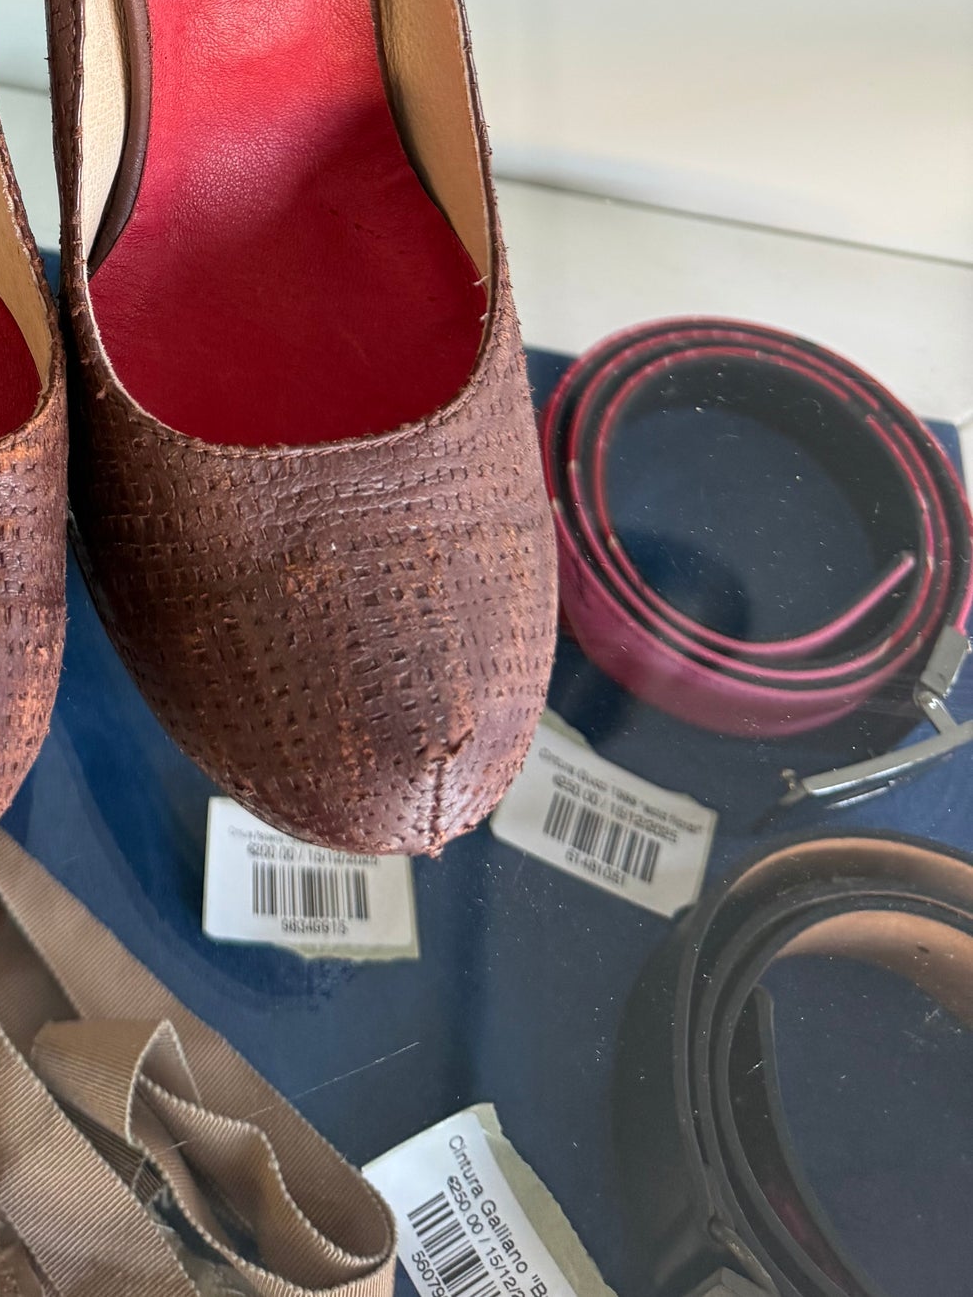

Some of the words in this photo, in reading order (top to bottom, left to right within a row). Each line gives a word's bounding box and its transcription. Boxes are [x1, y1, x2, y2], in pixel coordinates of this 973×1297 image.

[447, 1175, 484, 1234] €250.00
[449, 1135, 484, 1199] Cintura
[481, 1199, 528, 1274] Galliano
[530, 1273, 548, 1297] "B
